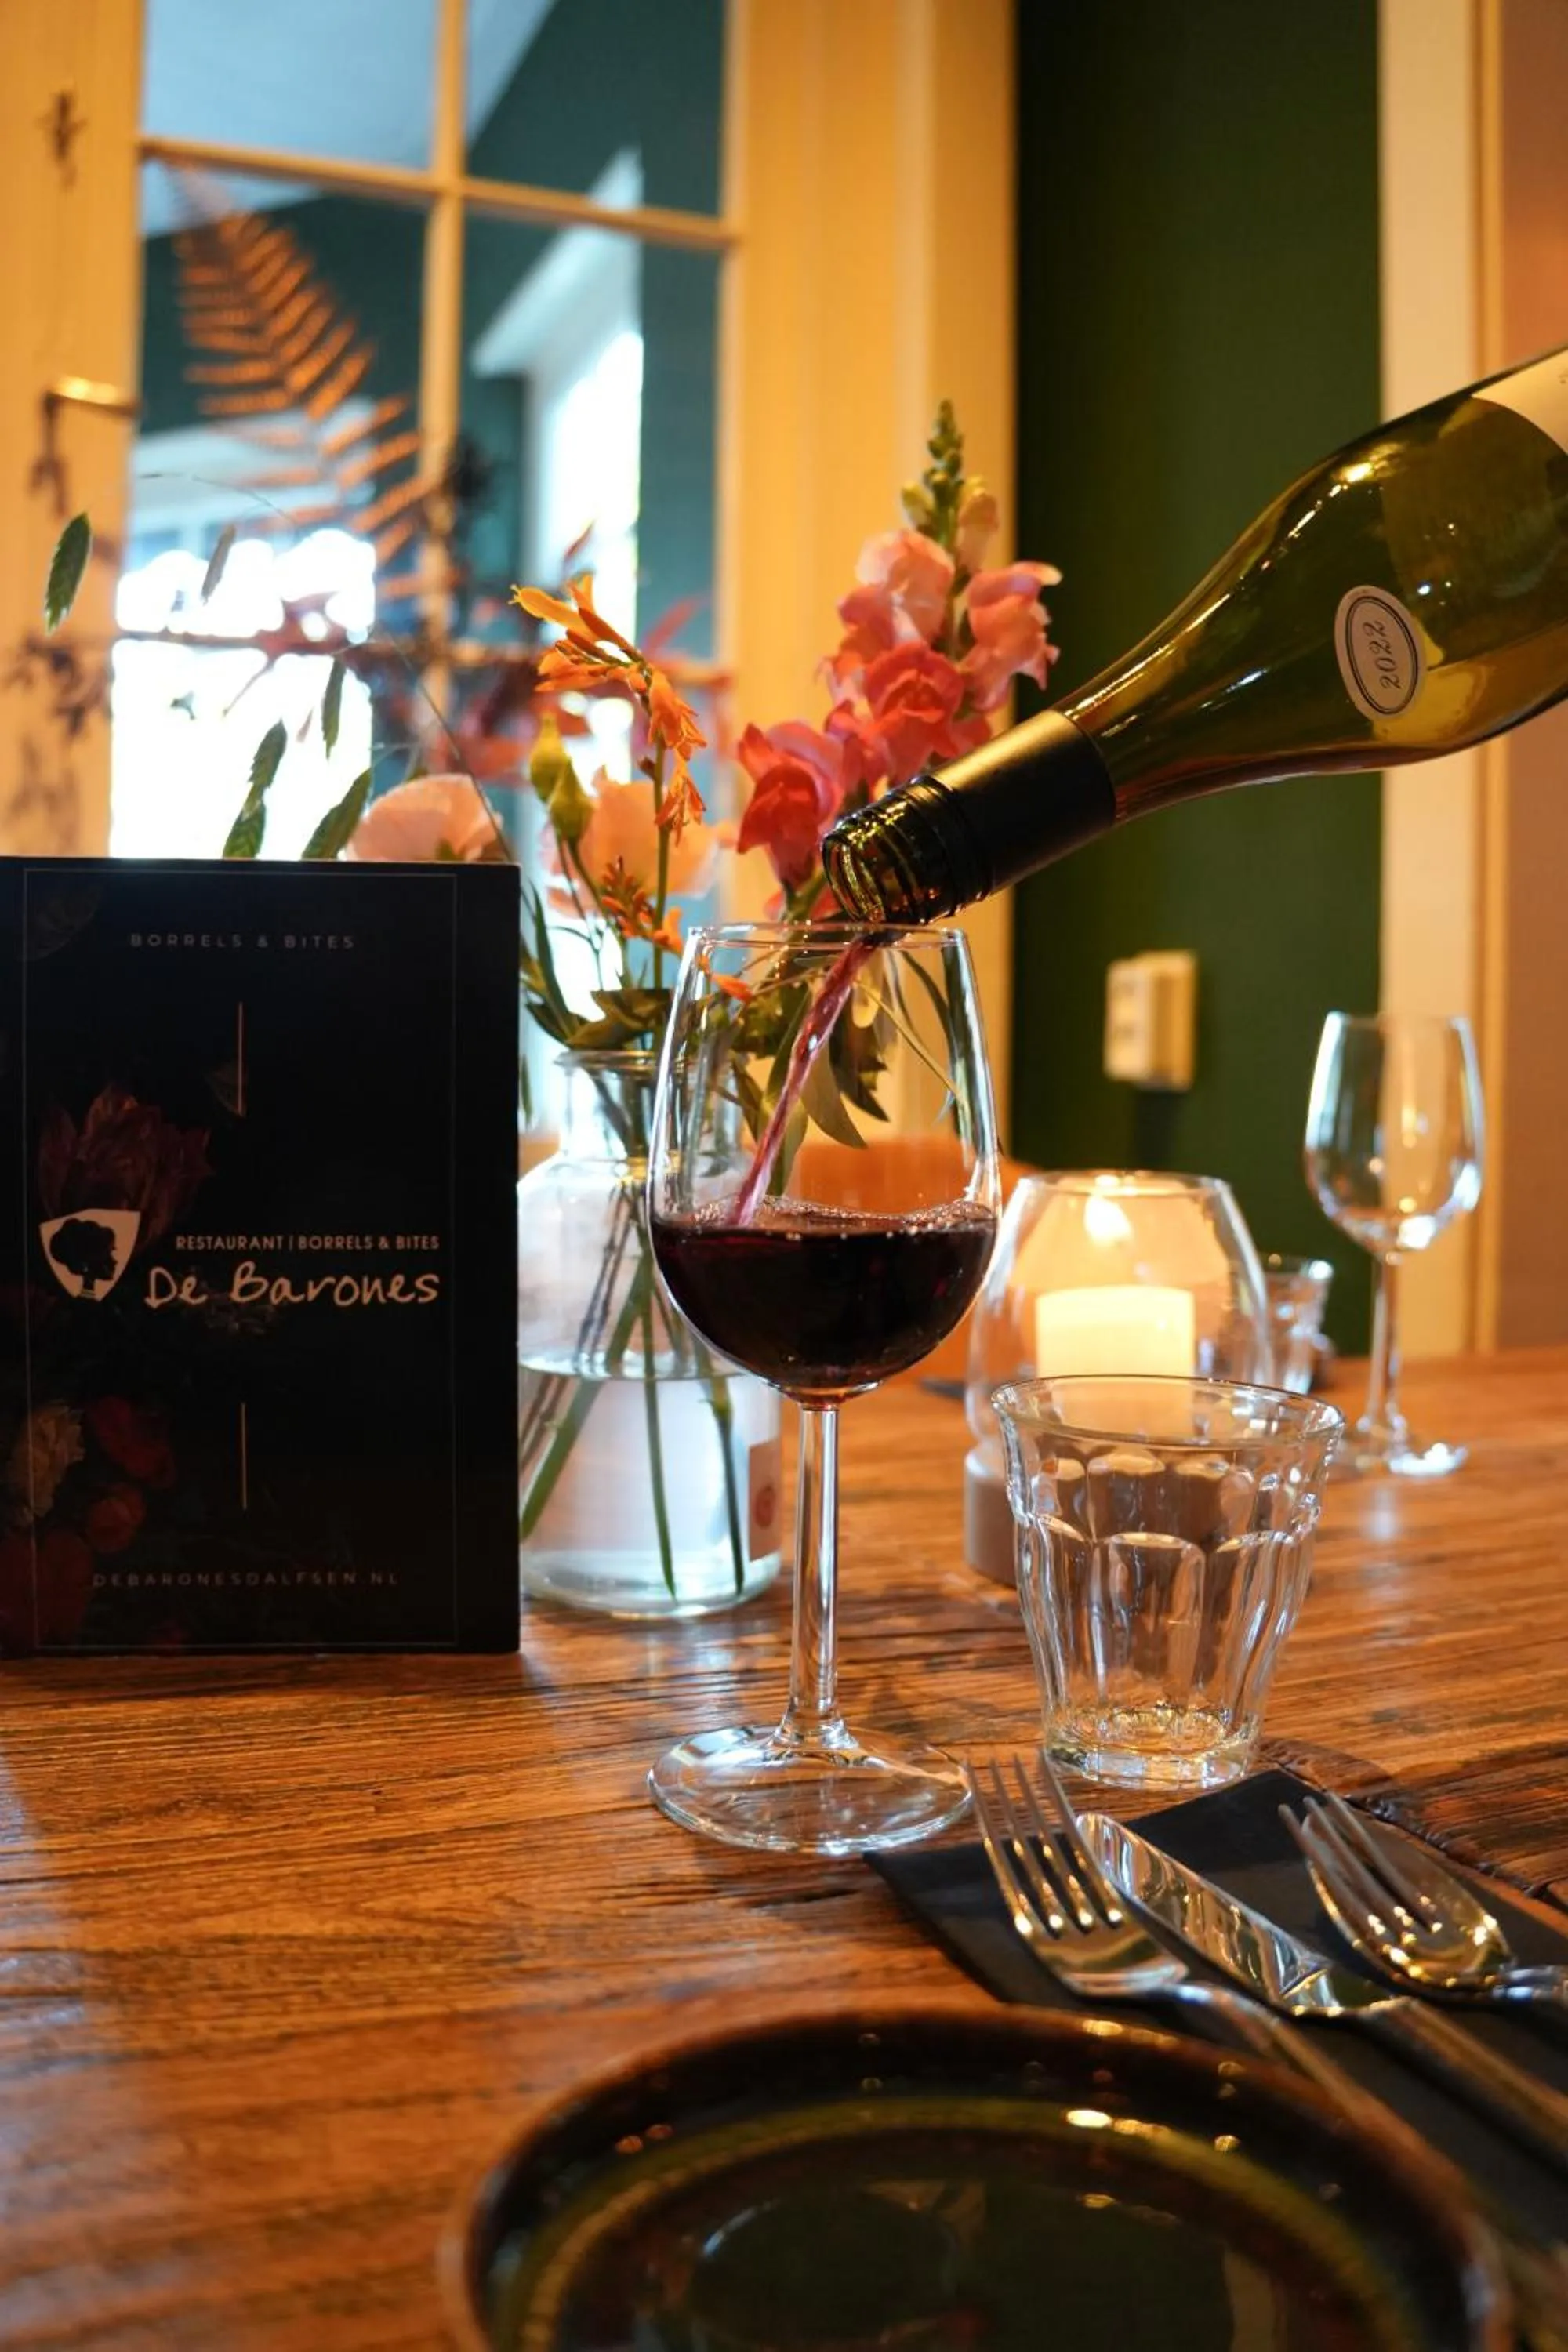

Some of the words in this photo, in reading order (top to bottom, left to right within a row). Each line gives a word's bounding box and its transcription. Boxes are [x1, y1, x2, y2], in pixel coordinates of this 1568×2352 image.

[1362, 620, 1402, 689] 2022
[129, 933, 242, 948] BORRELS
[256, 934, 268, 948] &
[284, 934, 354, 949] BITES
[175, 1235, 284, 1250] RESTAURANT
[297, 1235, 372, 1250] BORRELS
[378, 1235, 390, 1250] &
[394, 1235, 440, 1250] BITES
[144, 1266, 208, 1309] De
[227, 1260, 440, 1307] Barones
